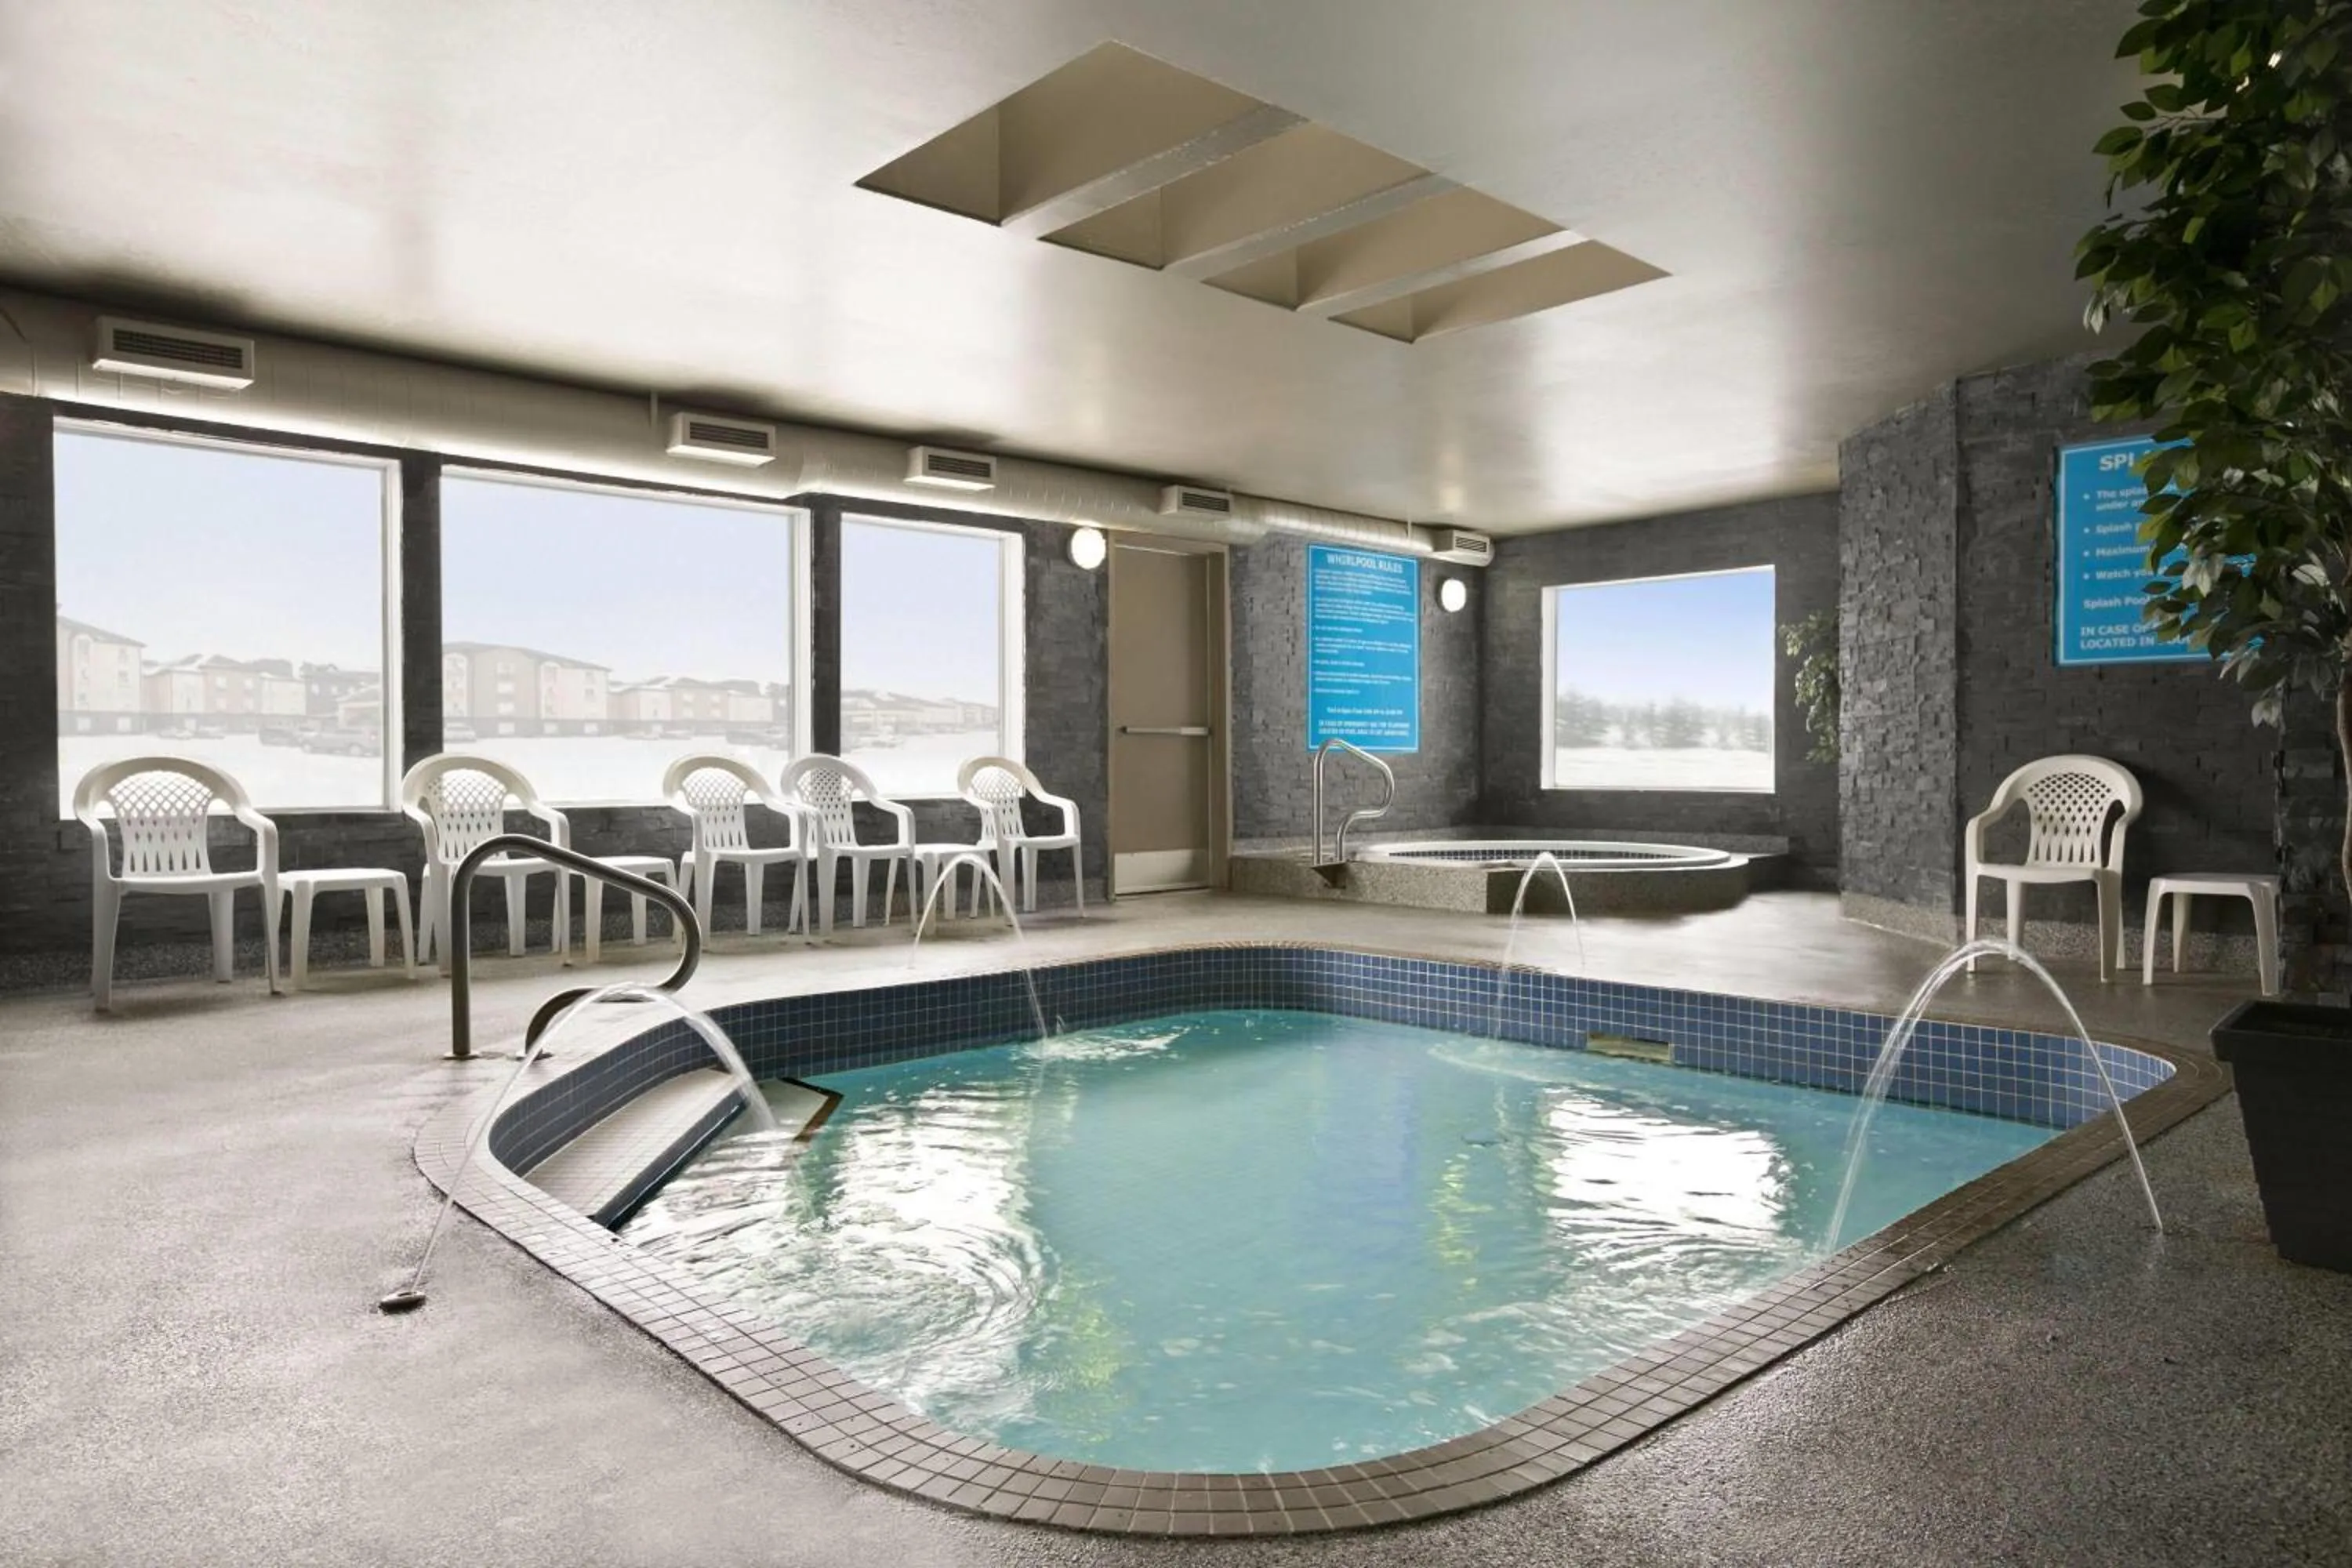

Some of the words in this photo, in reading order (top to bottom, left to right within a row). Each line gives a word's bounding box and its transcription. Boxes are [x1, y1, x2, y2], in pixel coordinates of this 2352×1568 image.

[2096, 490, 2117, 499] The
[2096, 521, 2132, 535] Splash
[2096, 569, 2131, 580] Watch
[2082, 597, 2122, 609] Splash
[2080, 626, 2096, 637] IN
[2098, 624, 2130, 636] CASE
[2080, 637, 2136, 650] LOCATED
[2139, 636, 2155, 647] IN
